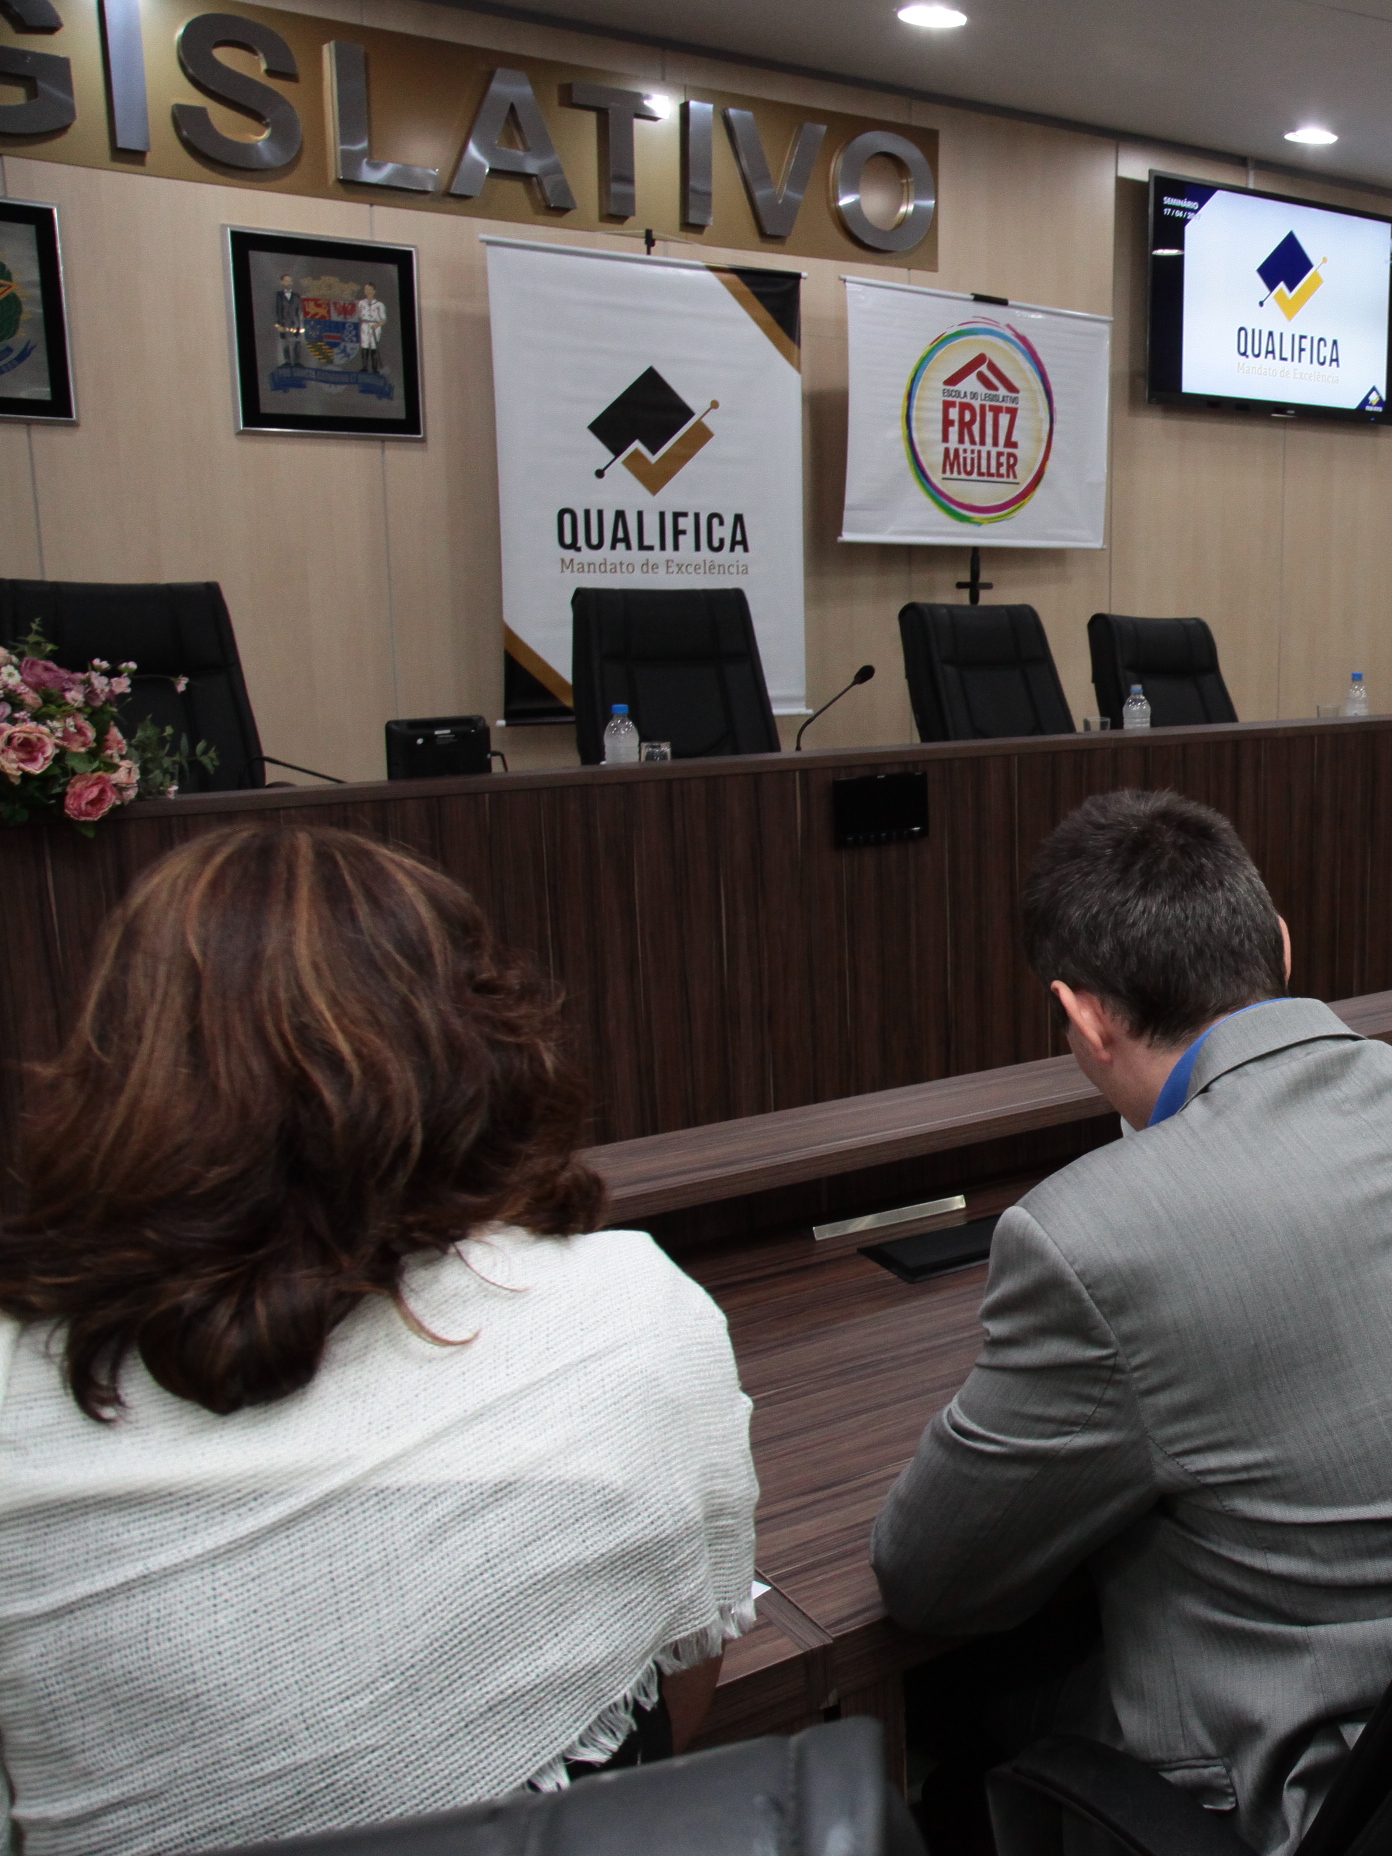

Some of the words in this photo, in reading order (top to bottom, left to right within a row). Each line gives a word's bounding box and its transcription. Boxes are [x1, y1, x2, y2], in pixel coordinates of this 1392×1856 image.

[1237, 326, 1340, 368] QUALIFICA
[1237, 362, 1277, 378] Mandato
[1280, 367, 1290, 378] de
[1293, 368, 1340, 384] Excelência
[942, 388, 967, 399] ESCOLA
[970, 391, 978, 400] DO
[980, 392, 1019, 405] LEGISLATIVO
[941, 399, 1019, 449] FRITZ
[941, 447, 1018, 479] MÜLLER
[557, 507, 750, 553] QUALIFICA
[560, 558, 635, 574] Mandato
[640, 558, 659, 574] de
[665, 559, 749, 575] Excelência
